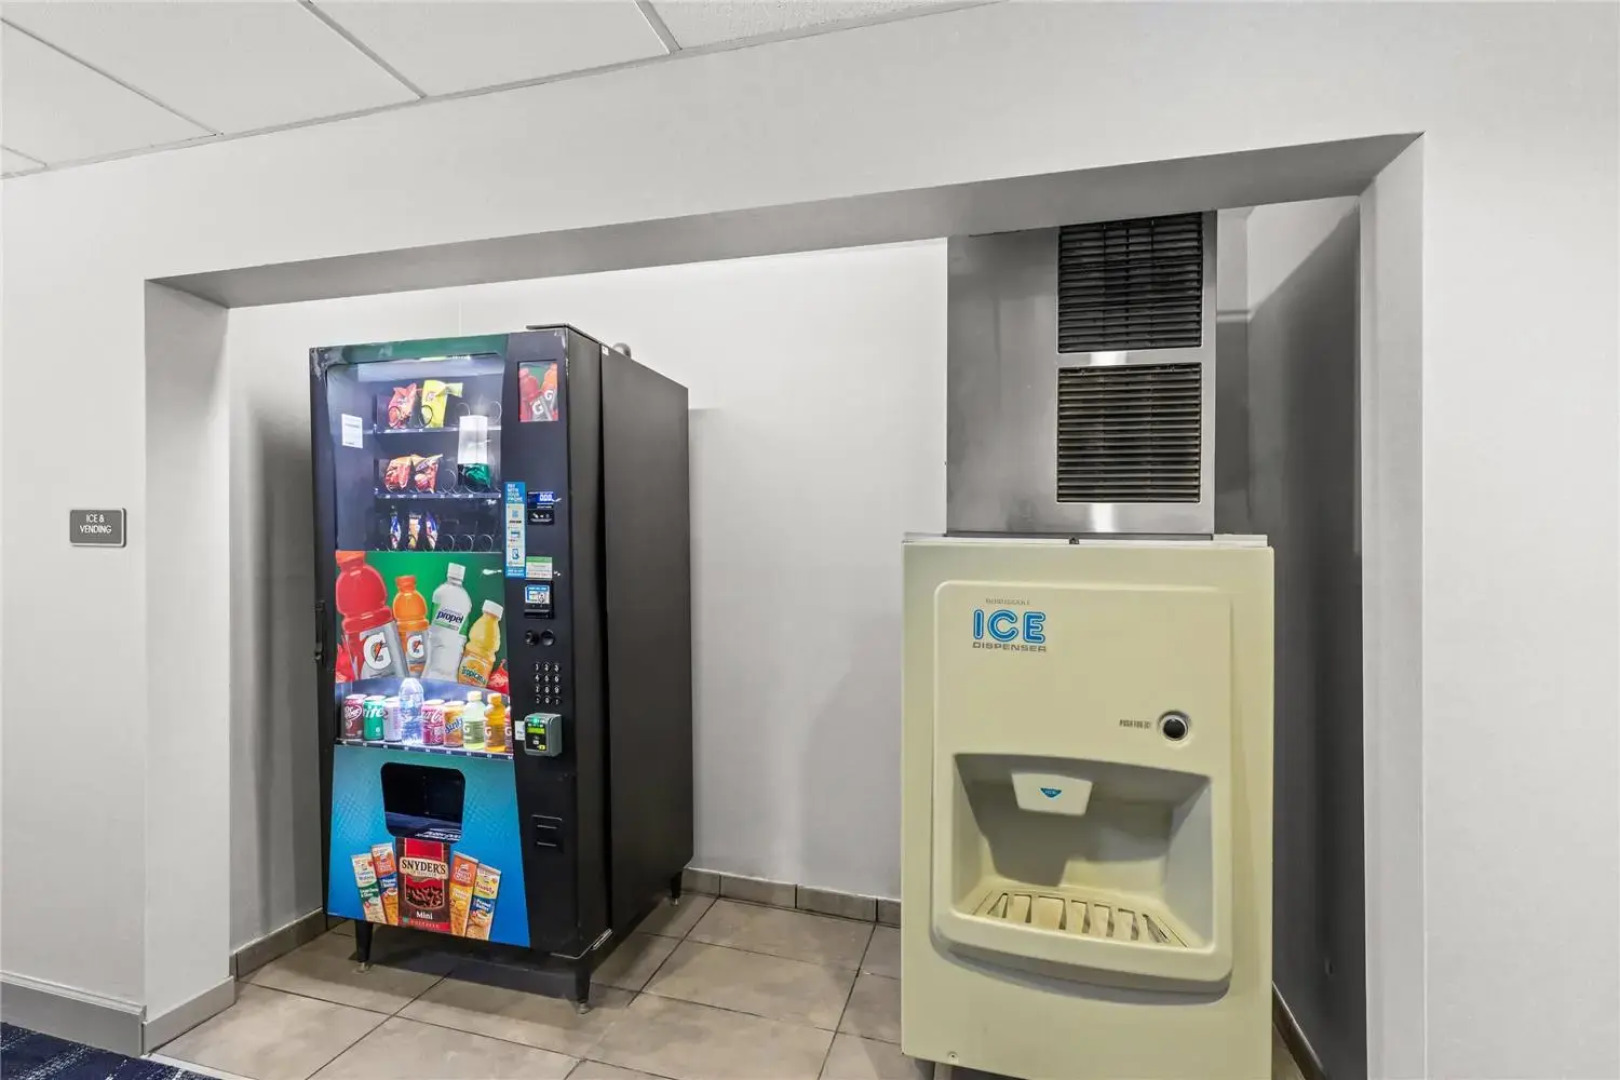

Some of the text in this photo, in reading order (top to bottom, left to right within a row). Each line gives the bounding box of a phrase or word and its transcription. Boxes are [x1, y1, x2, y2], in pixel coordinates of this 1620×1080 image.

[86, 514, 98, 523] ICE
[79, 525, 112, 534] VENDING
[436, 610, 464, 624] propel
[973, 609, 1047, 644] ICE
[972, 641, 1048, 653] DISPENSER
[401, 859, 446, 875] SNYDER'S
[416, 910, 433, 920] Mini
